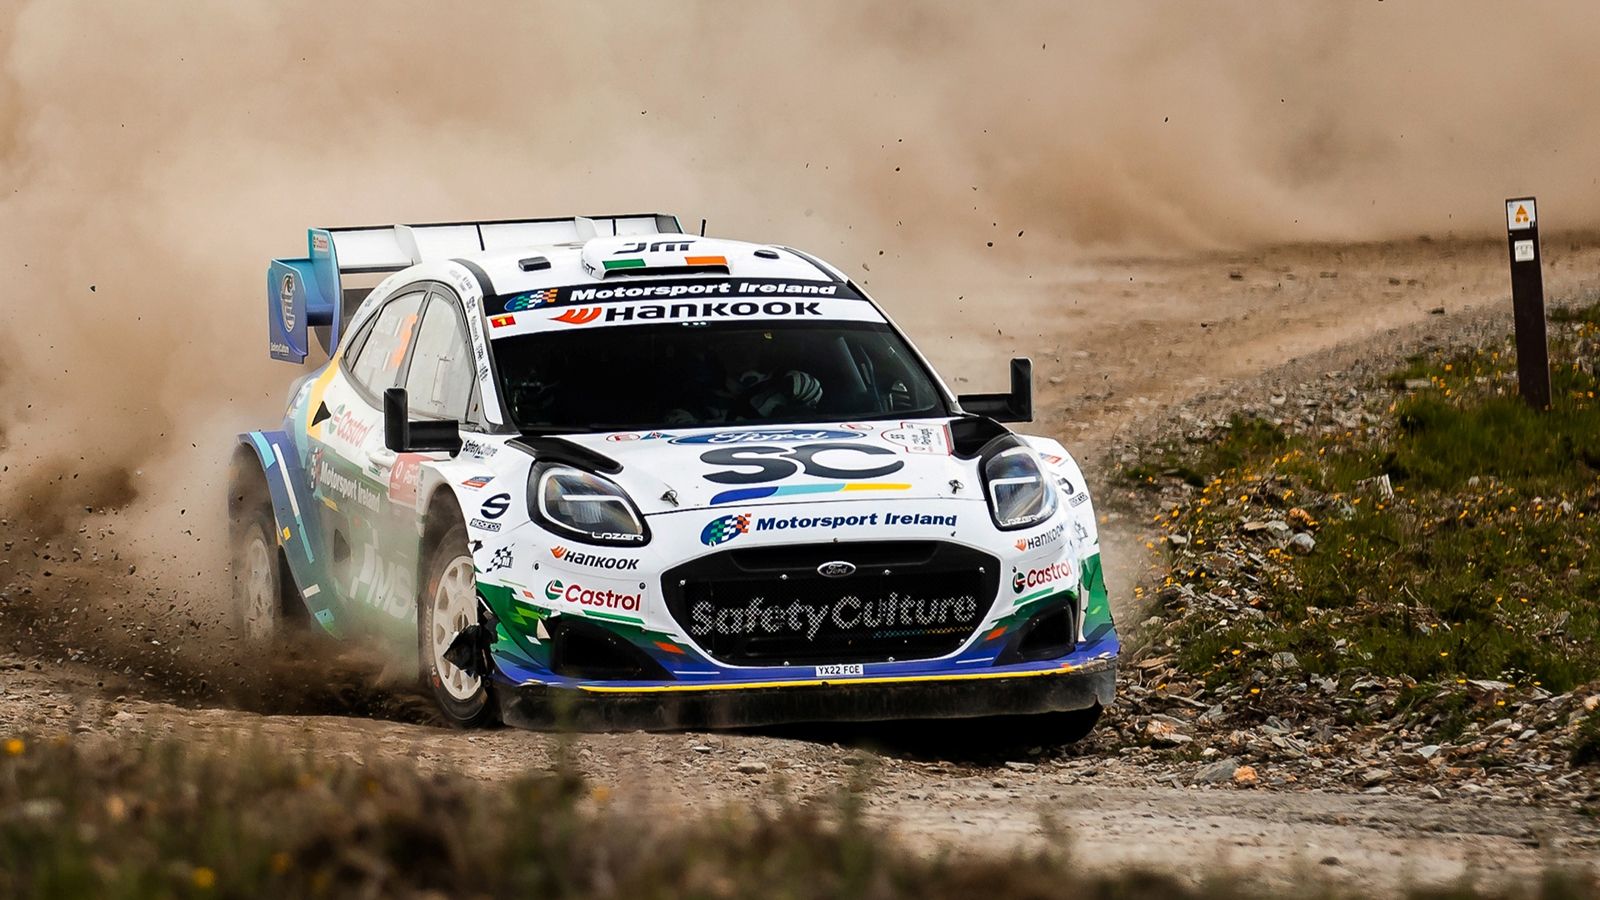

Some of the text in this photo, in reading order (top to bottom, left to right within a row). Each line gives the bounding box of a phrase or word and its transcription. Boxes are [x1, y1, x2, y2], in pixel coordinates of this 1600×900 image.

[570, 282, 837, 301] Motorsport Ireland
[708, 430, 829, 443] Ford
[700, 443, 905, 484] SC
[320, 461, 358, 501] Motorsport
[756, 512, 957, 531] Motorsport Ireland
[826, 563, 848, 575] Ford
[1026, 559, 1072, 588] Castrol
[565, 584, 641, 612] Castrol
[691, 592, 977, 641] SafetyCulture
[818, 666, 841, 675] YX22
